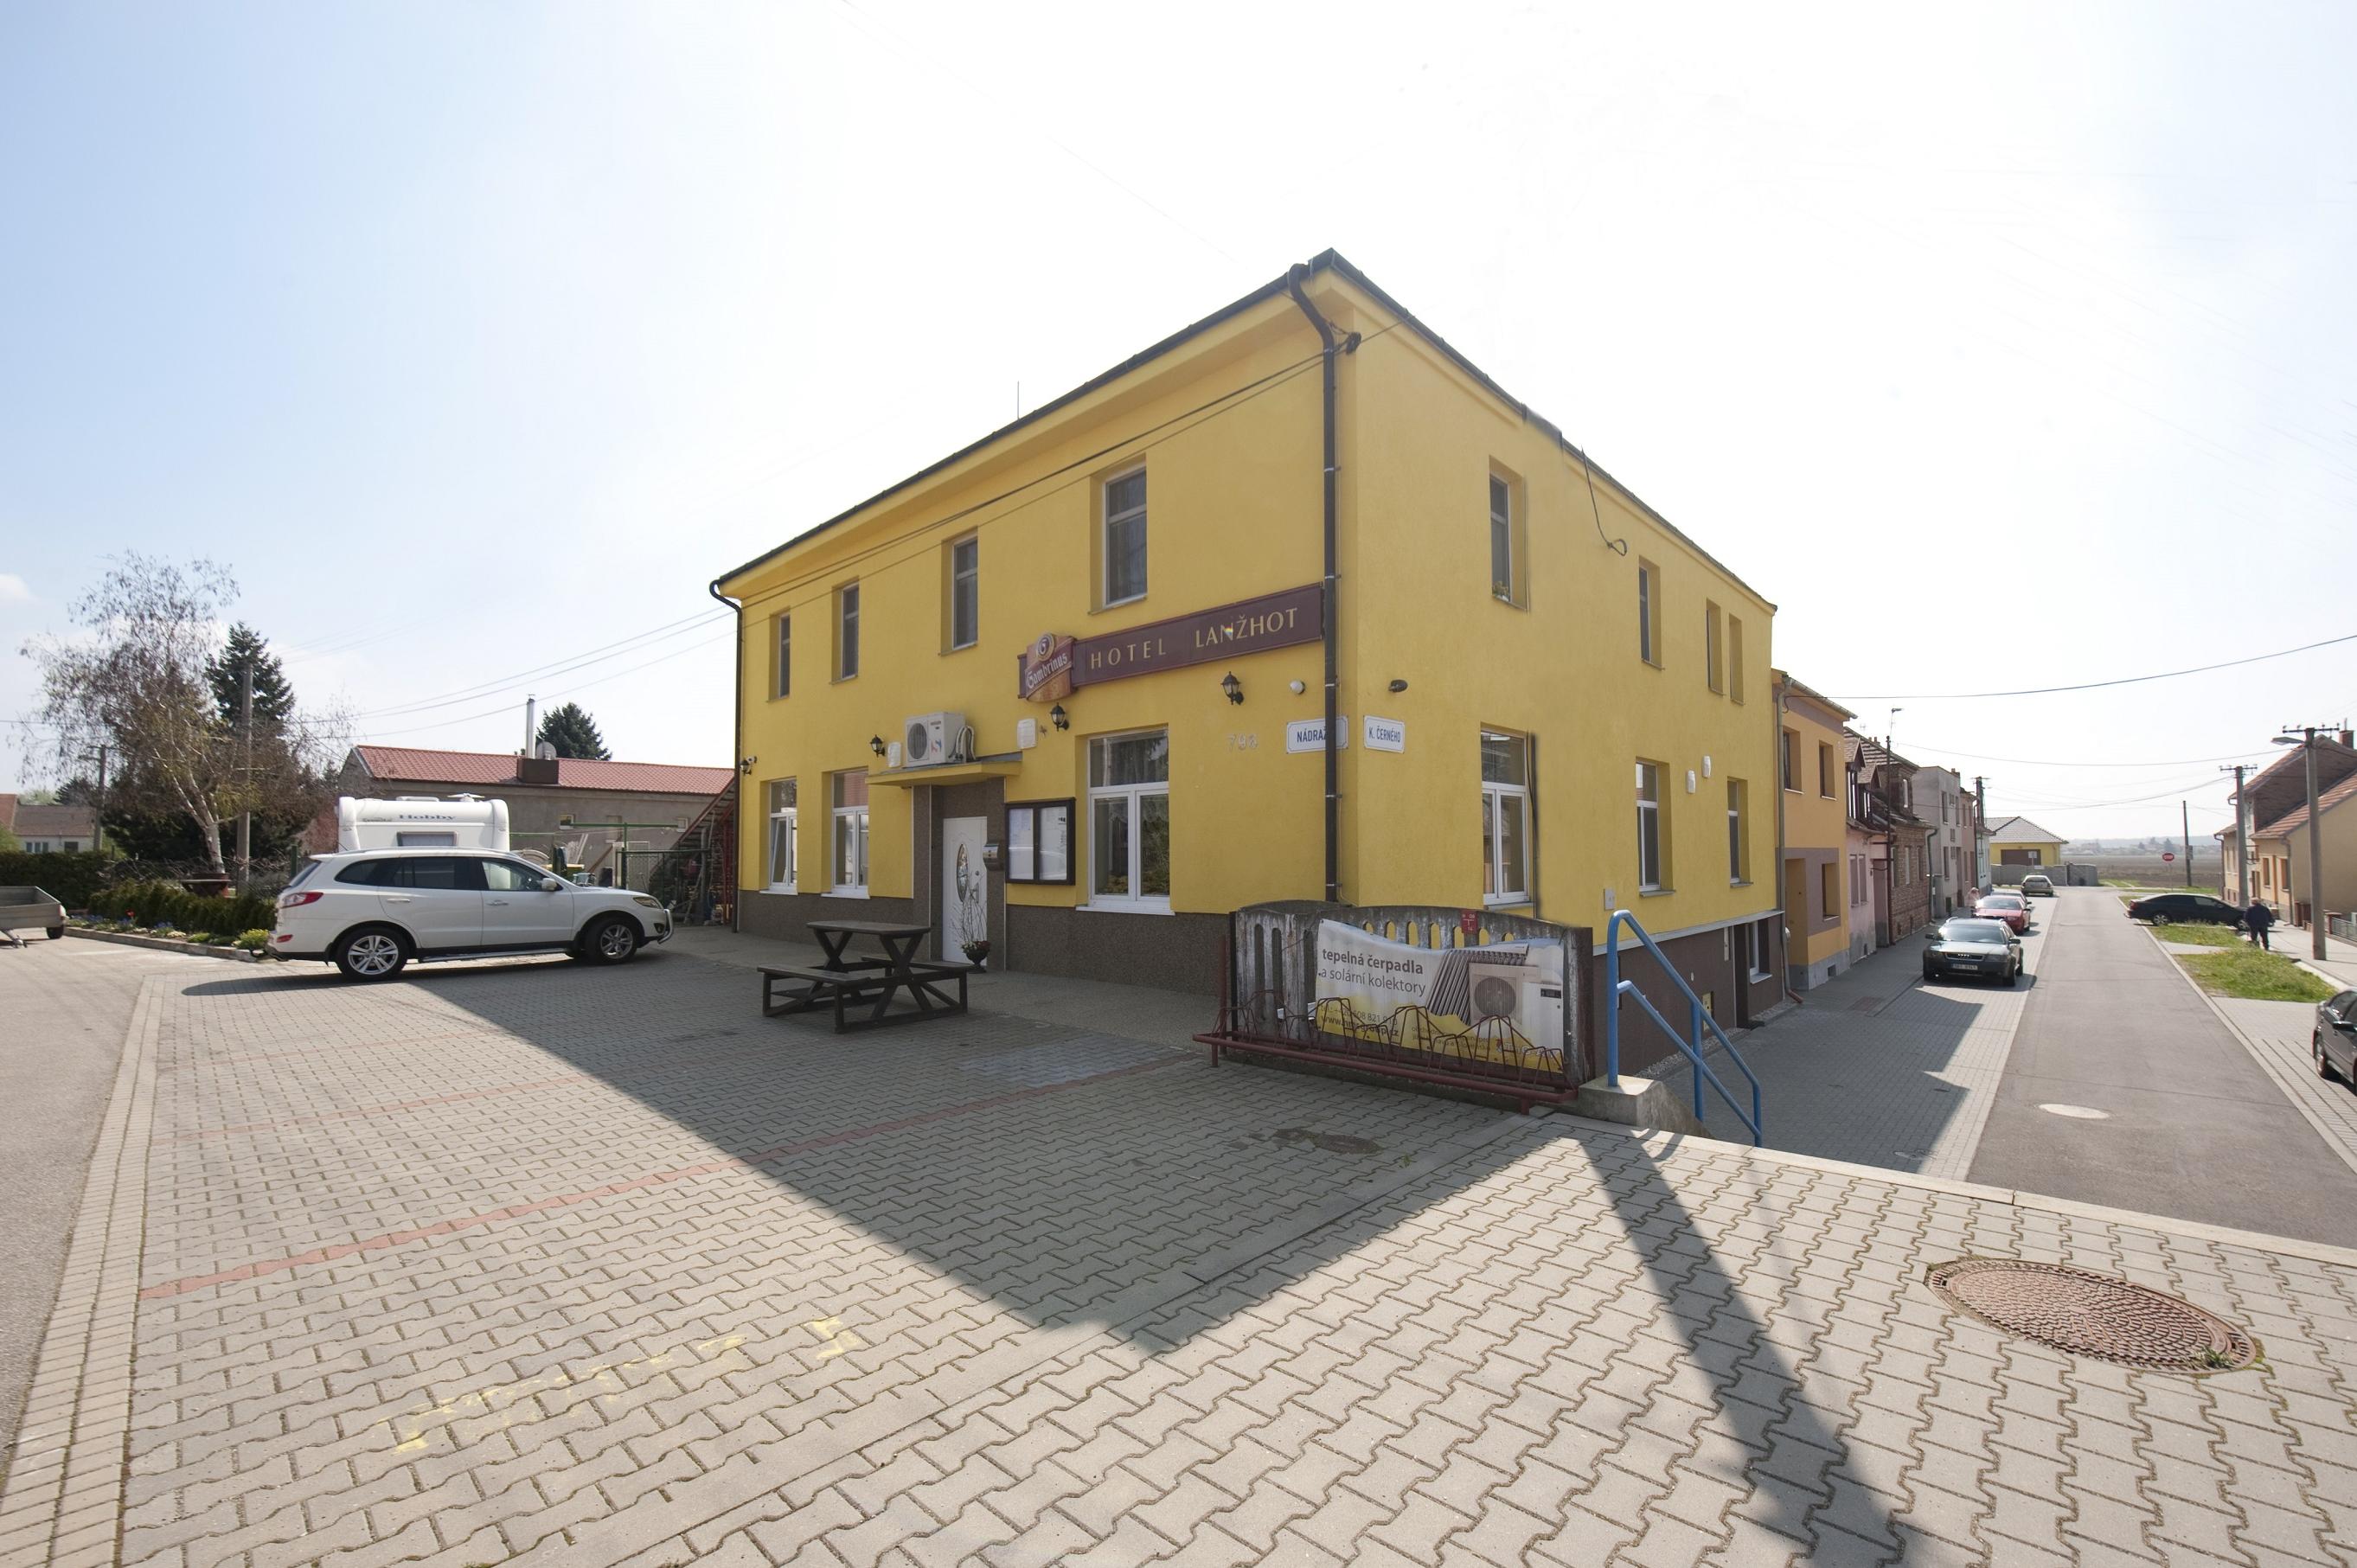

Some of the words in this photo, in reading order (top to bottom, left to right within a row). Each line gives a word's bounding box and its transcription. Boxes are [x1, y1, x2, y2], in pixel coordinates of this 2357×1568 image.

[1091, 638, 1166, 669] HOTEL
[1195, 607, 1297, 648] LANŽHOT
[1027, 653, 1068, 689] Gambrinus
[1369, 726, 1375, 739] K.
[1377, 725, 1400, 743] ČERNÉHO
[1323, 949, 1364, 965] tepelná
[1367, 955, 1424, 975] čerpadla
[1321, 969, 1327, 978] a
[1329, 969, 1366, 985] solární
[1368, 973, 1426, 997] kolektory
